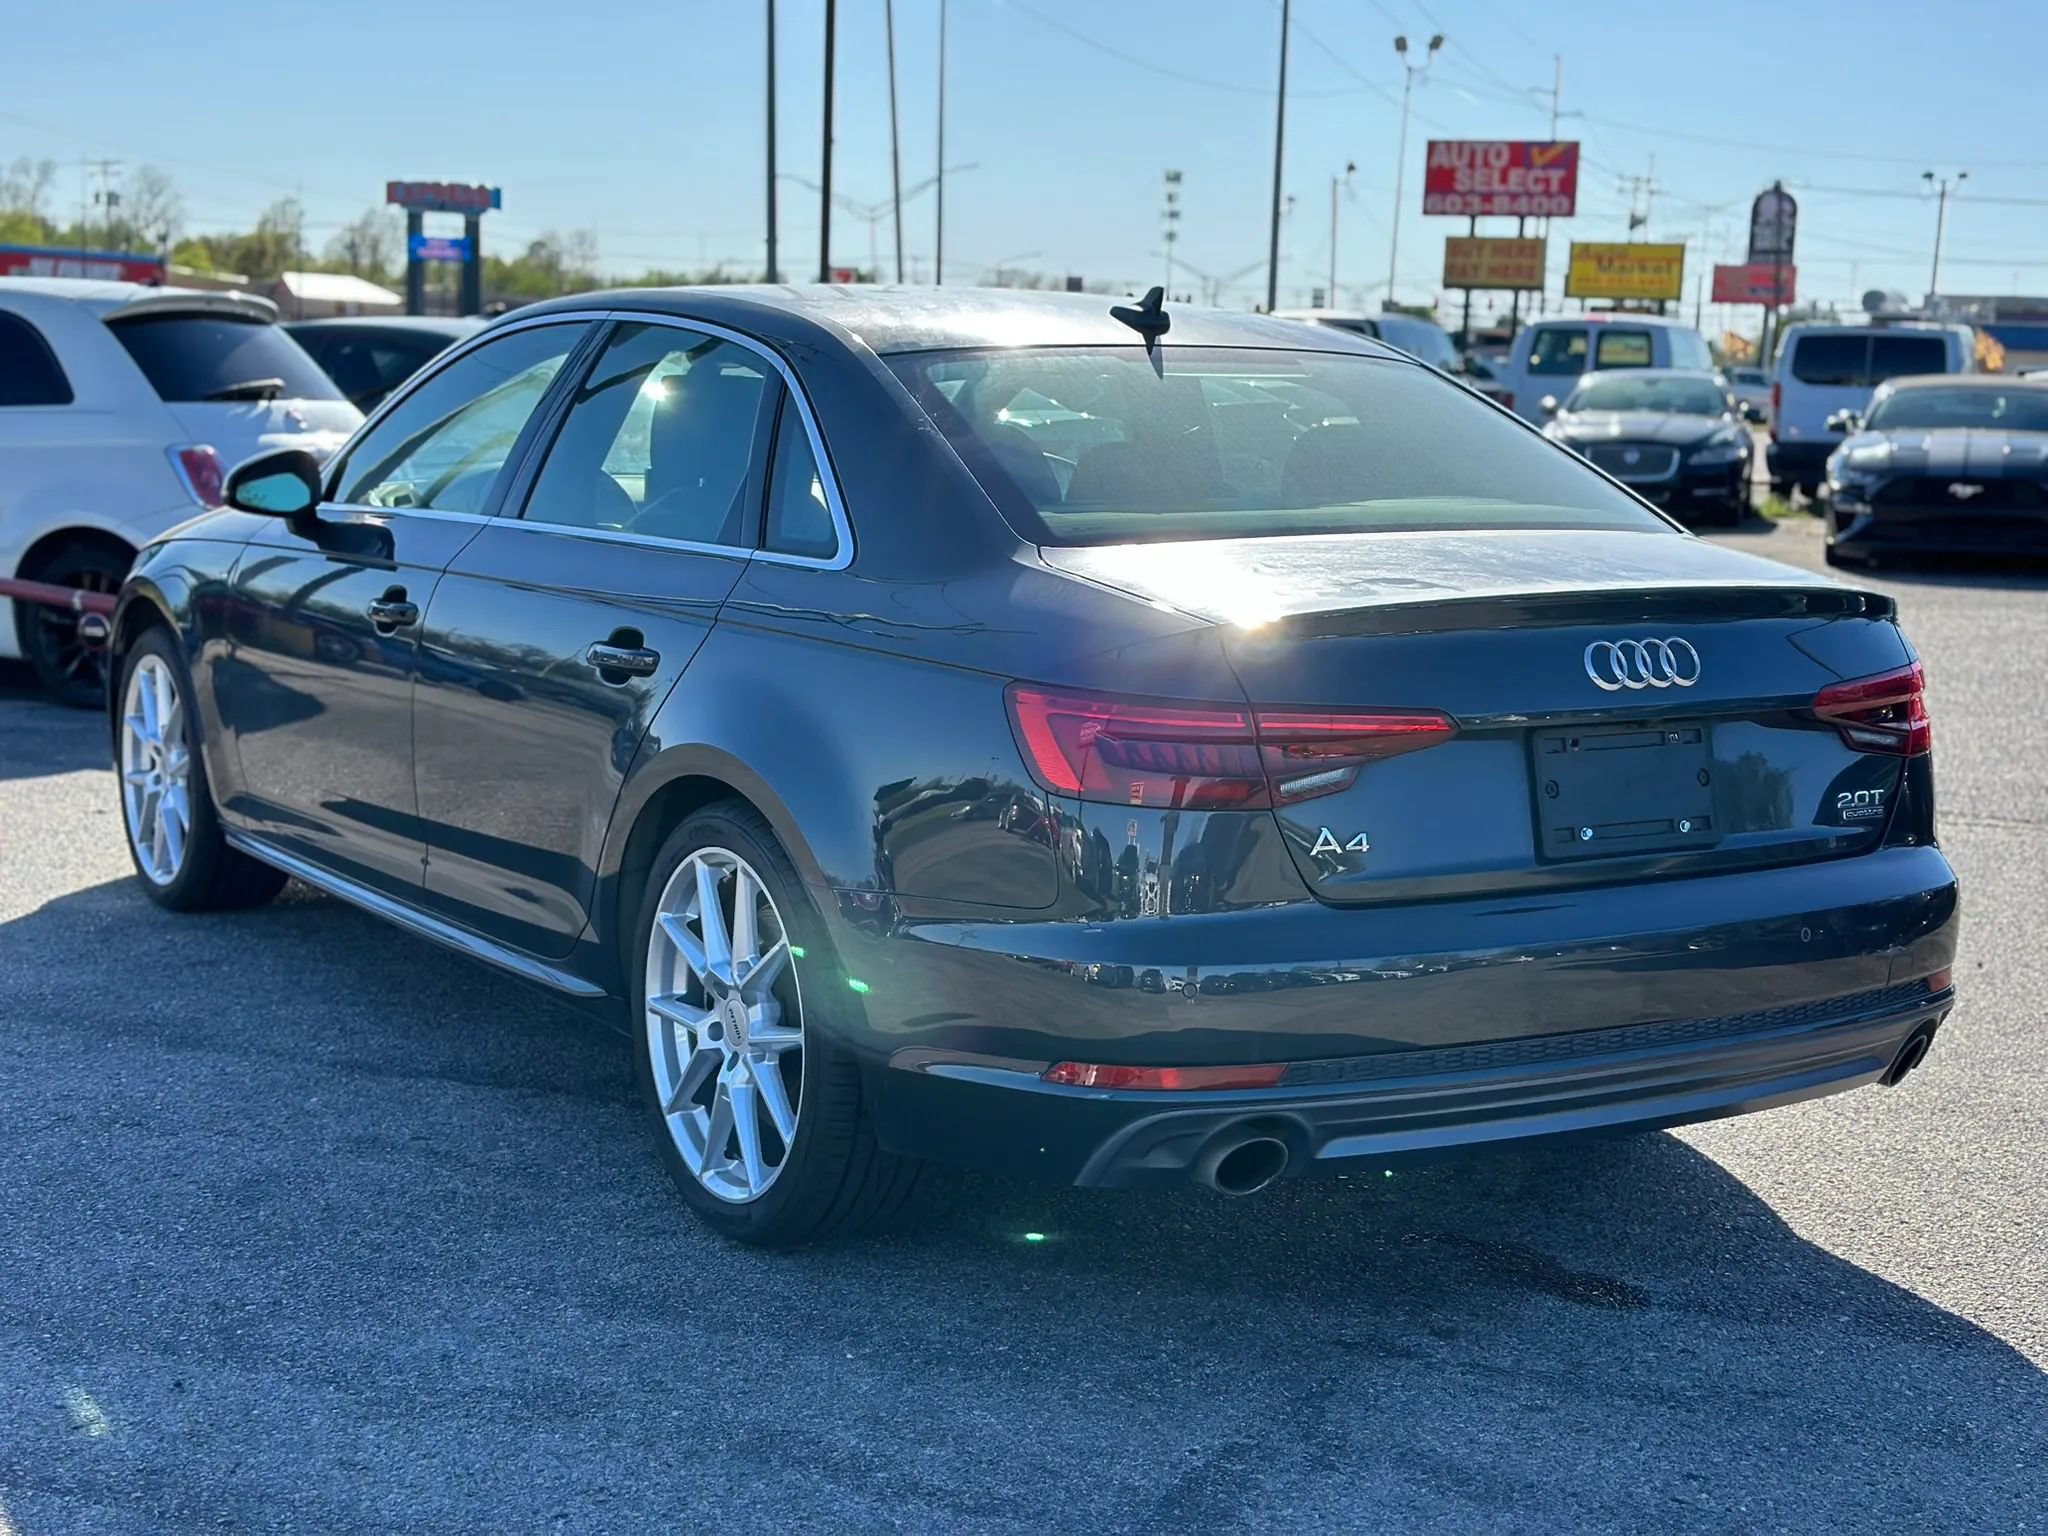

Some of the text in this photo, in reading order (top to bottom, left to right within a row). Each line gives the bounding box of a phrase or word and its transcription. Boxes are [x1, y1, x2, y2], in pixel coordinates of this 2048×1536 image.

[1428, 142, 1511, 168] AUTO
[1453, 167, 1567, 194] SELECT
[1837, 789, 1885, 808] 2.0T
[1309, 826, 1370, 856] A4
[729, 1008, 741, 1039] PETROL
